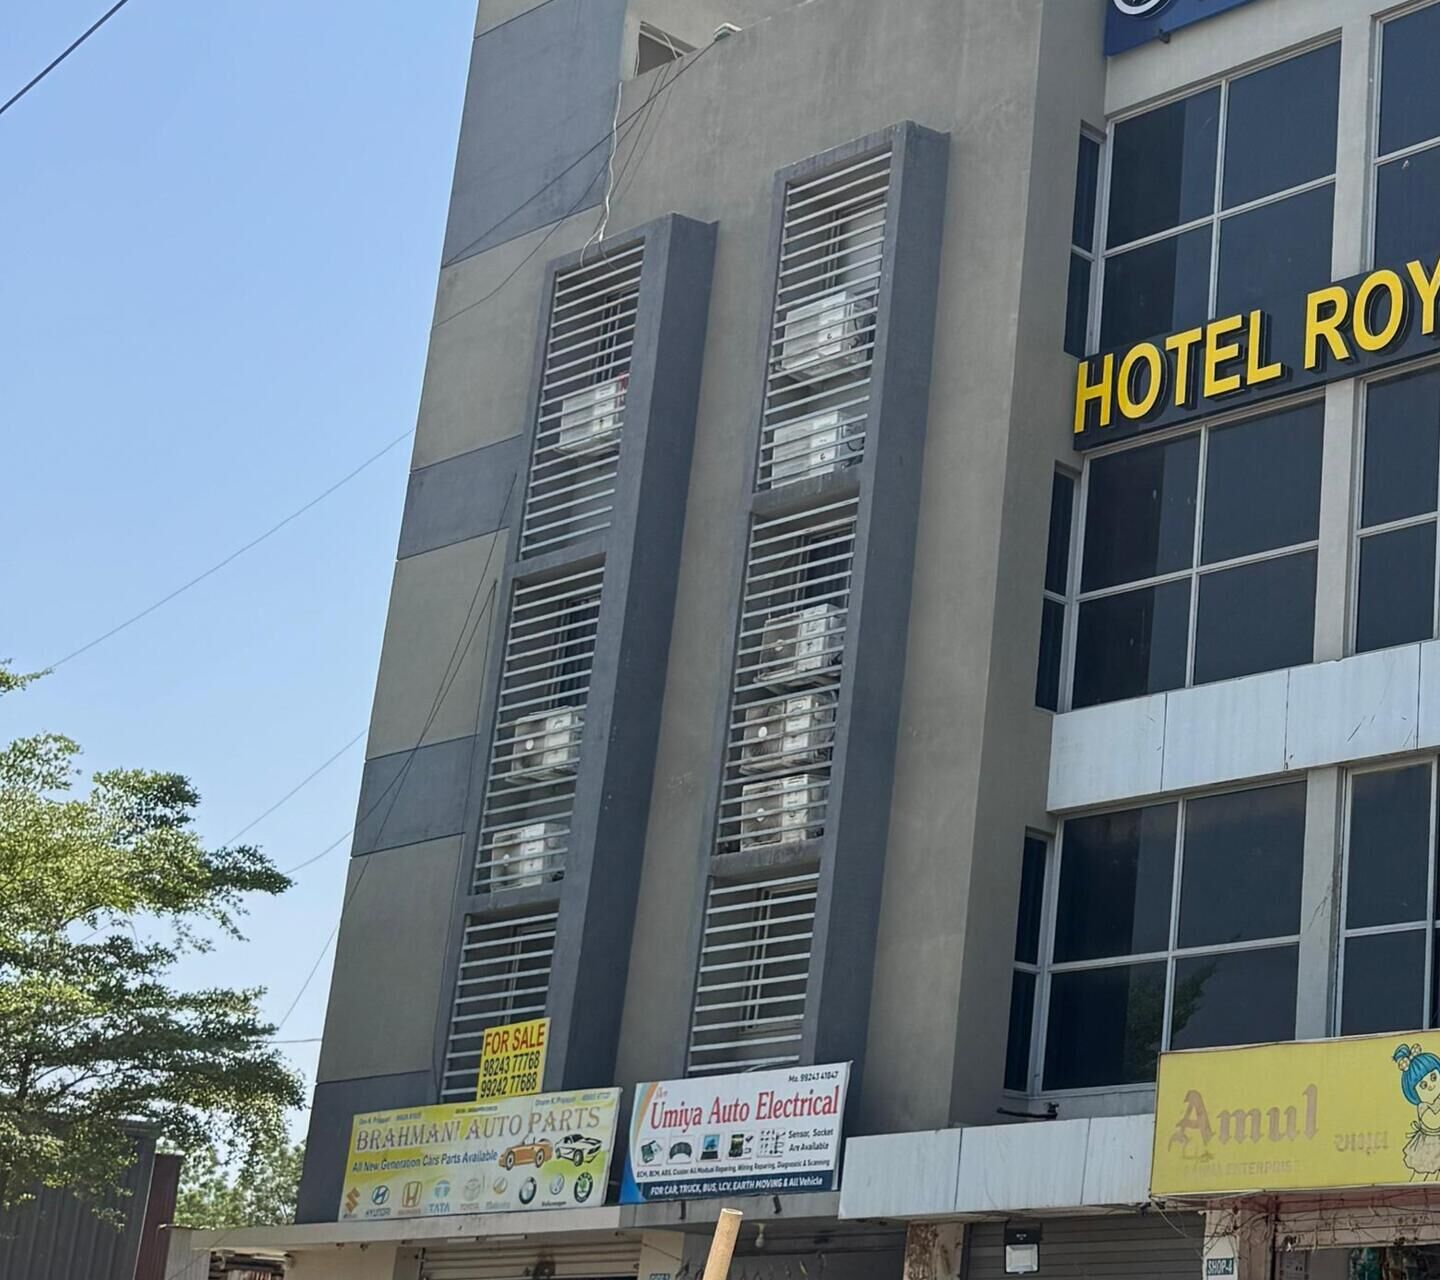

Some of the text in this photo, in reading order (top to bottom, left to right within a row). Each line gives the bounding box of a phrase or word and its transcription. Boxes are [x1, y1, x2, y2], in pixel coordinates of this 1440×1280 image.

[1074, 308, 1283, 434] HOTEL
[483, 1023, 546, 1056] FOR SALE
[480, 1076, 508, 1098] 99242
[650, 1085, 839, 1133] Umiya Auto Electrical
[1168, 1083, 1320, 1156] Amul
[356, 1106, 601, 1152] BRAHMANI AUTO PARTS
[352, 1160, 363, 1172] All
[364, 1160, 379, 1171] New
[423, 1154, 440, 1167] Cars
[441, 1153, 461, 1166] Parts
[463, 1150, 498, 1165] Available
[733, 1179, 755, 1191] EARTH
[428, 1203, 450, 1213] TATA
